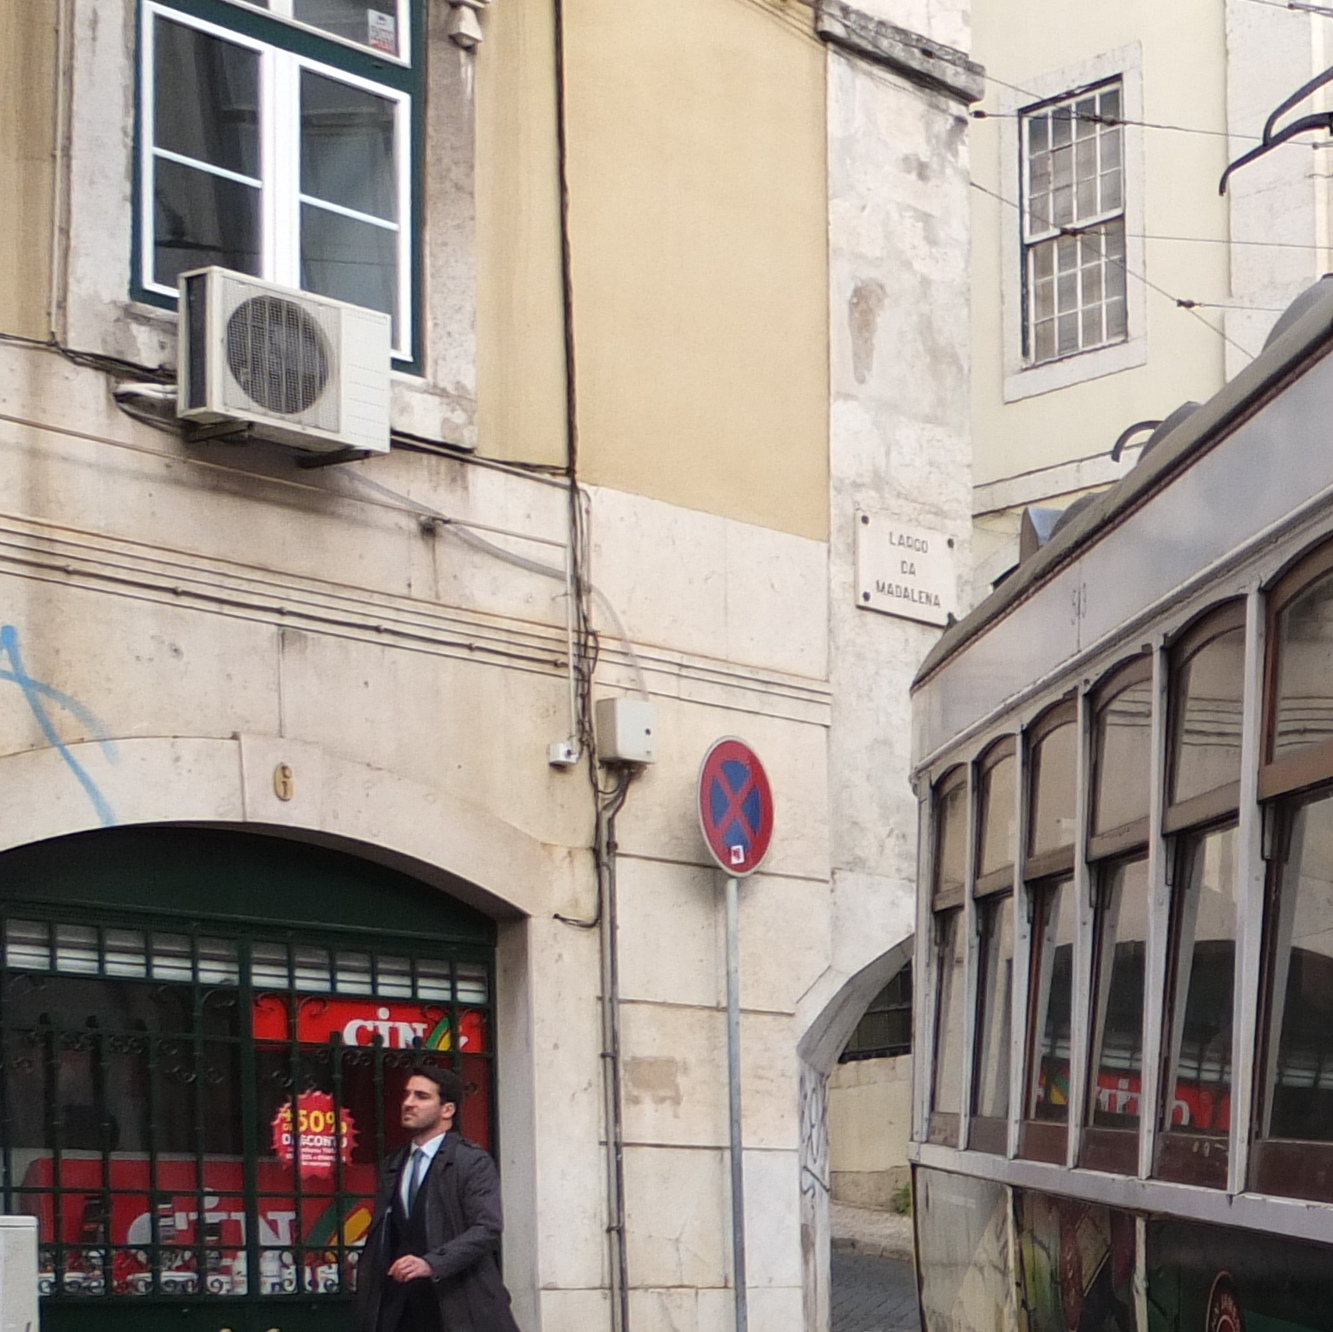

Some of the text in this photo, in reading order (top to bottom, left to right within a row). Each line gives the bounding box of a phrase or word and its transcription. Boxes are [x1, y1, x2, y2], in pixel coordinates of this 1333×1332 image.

[889, 531, 929, 554] LARGO
[900, 560, 917, 576] DA
[875, 580, 941, 608] MADALENA
